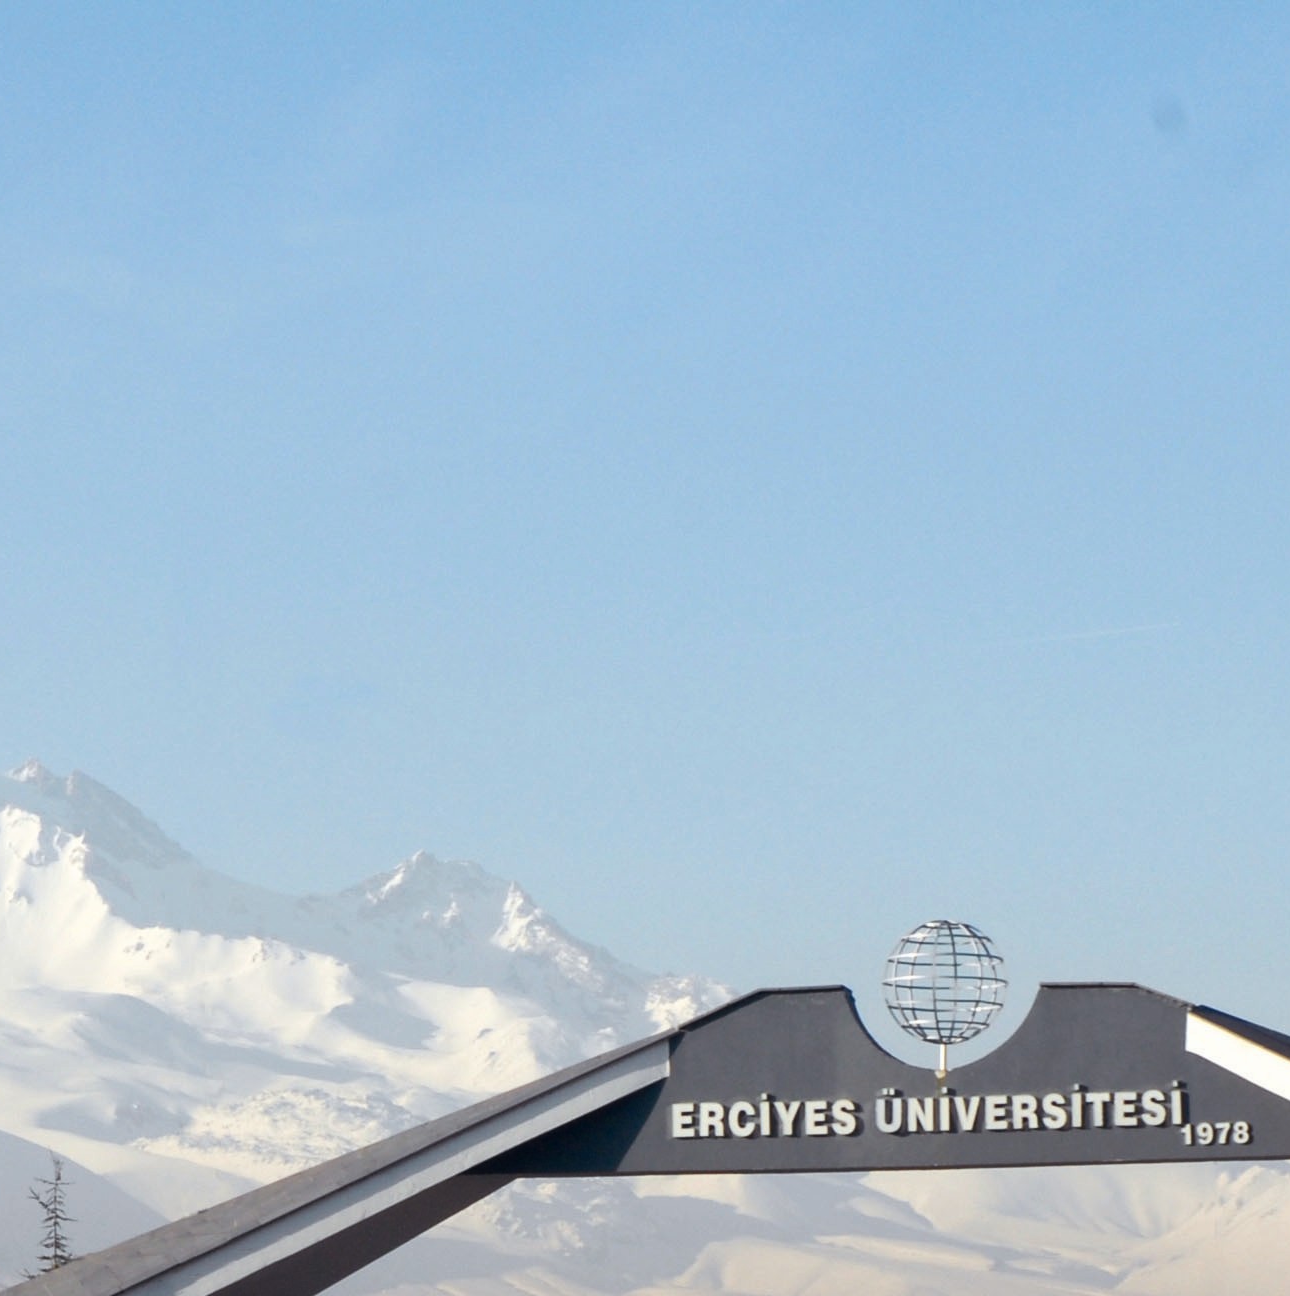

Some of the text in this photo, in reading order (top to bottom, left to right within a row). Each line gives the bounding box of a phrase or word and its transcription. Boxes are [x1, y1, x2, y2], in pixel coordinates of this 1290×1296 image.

[672, 1080, 1183, 1137] ERCİYES ÜNİVERSİTESİ
[1181, 1121, 1250, 1145] 1978
